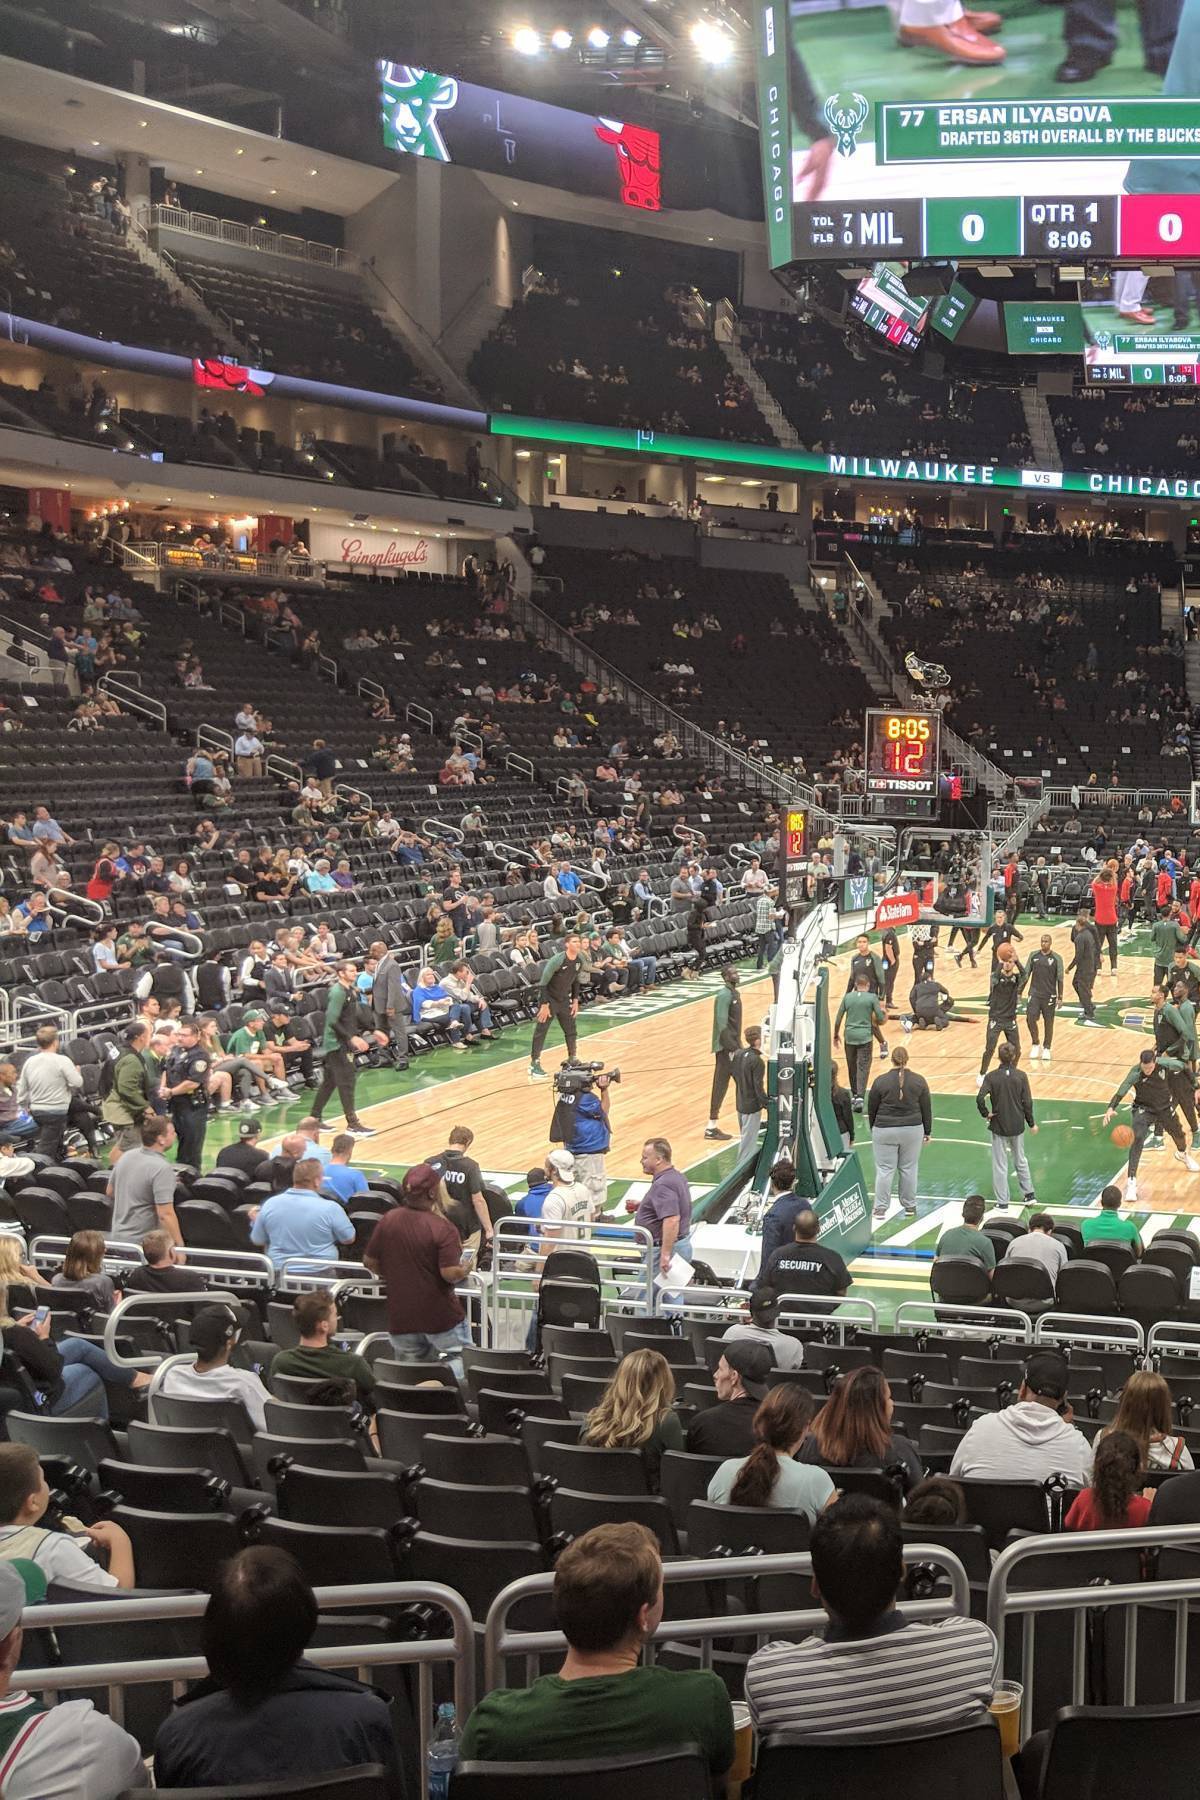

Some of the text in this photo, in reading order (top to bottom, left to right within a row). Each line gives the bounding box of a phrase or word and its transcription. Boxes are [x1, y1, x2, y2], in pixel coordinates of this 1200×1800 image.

[900, 105, 1112, 128] 77 ERSAN ILYASOVA
[940, 131, 1001, 146] DRAFTED
[1003, 129, 1039, 145] 36TH
[1041, 128, 1105, 145] OVERALL
[1106, 128, 1124, 144] BY
[1126, 128, 1153, 143] THE
[769, 85, 784, 223] CHICAGO
[812, 213, 852, 227] TOL 7
[1031, 203, 1098, 223] QTR 1
[860, 211, 903, 245] MIL
[961, 213, 985, 242] 0
[1158, 213, 1183, 242] 0
[813, 231, 853, 245] FLS 0
[1047, 230, 1092, 249] 8:06
[1109, 368, 1125, 380] MIL
[1143, 368, 1152, 380] 0
[1168, 374, 1187, 382] 8:06
[829, 455, 995, 484] MILWAUKEE
[1034, 474, 1051, 484] VS
[888, 717, 930, 740] 8:05
[895, 740, 923, 773] 12
[887, 780, 933, 791] TISSOT
[445, 1170, 466, 1184] OTO
[779, 1259, 823, 1273] SECURITY
